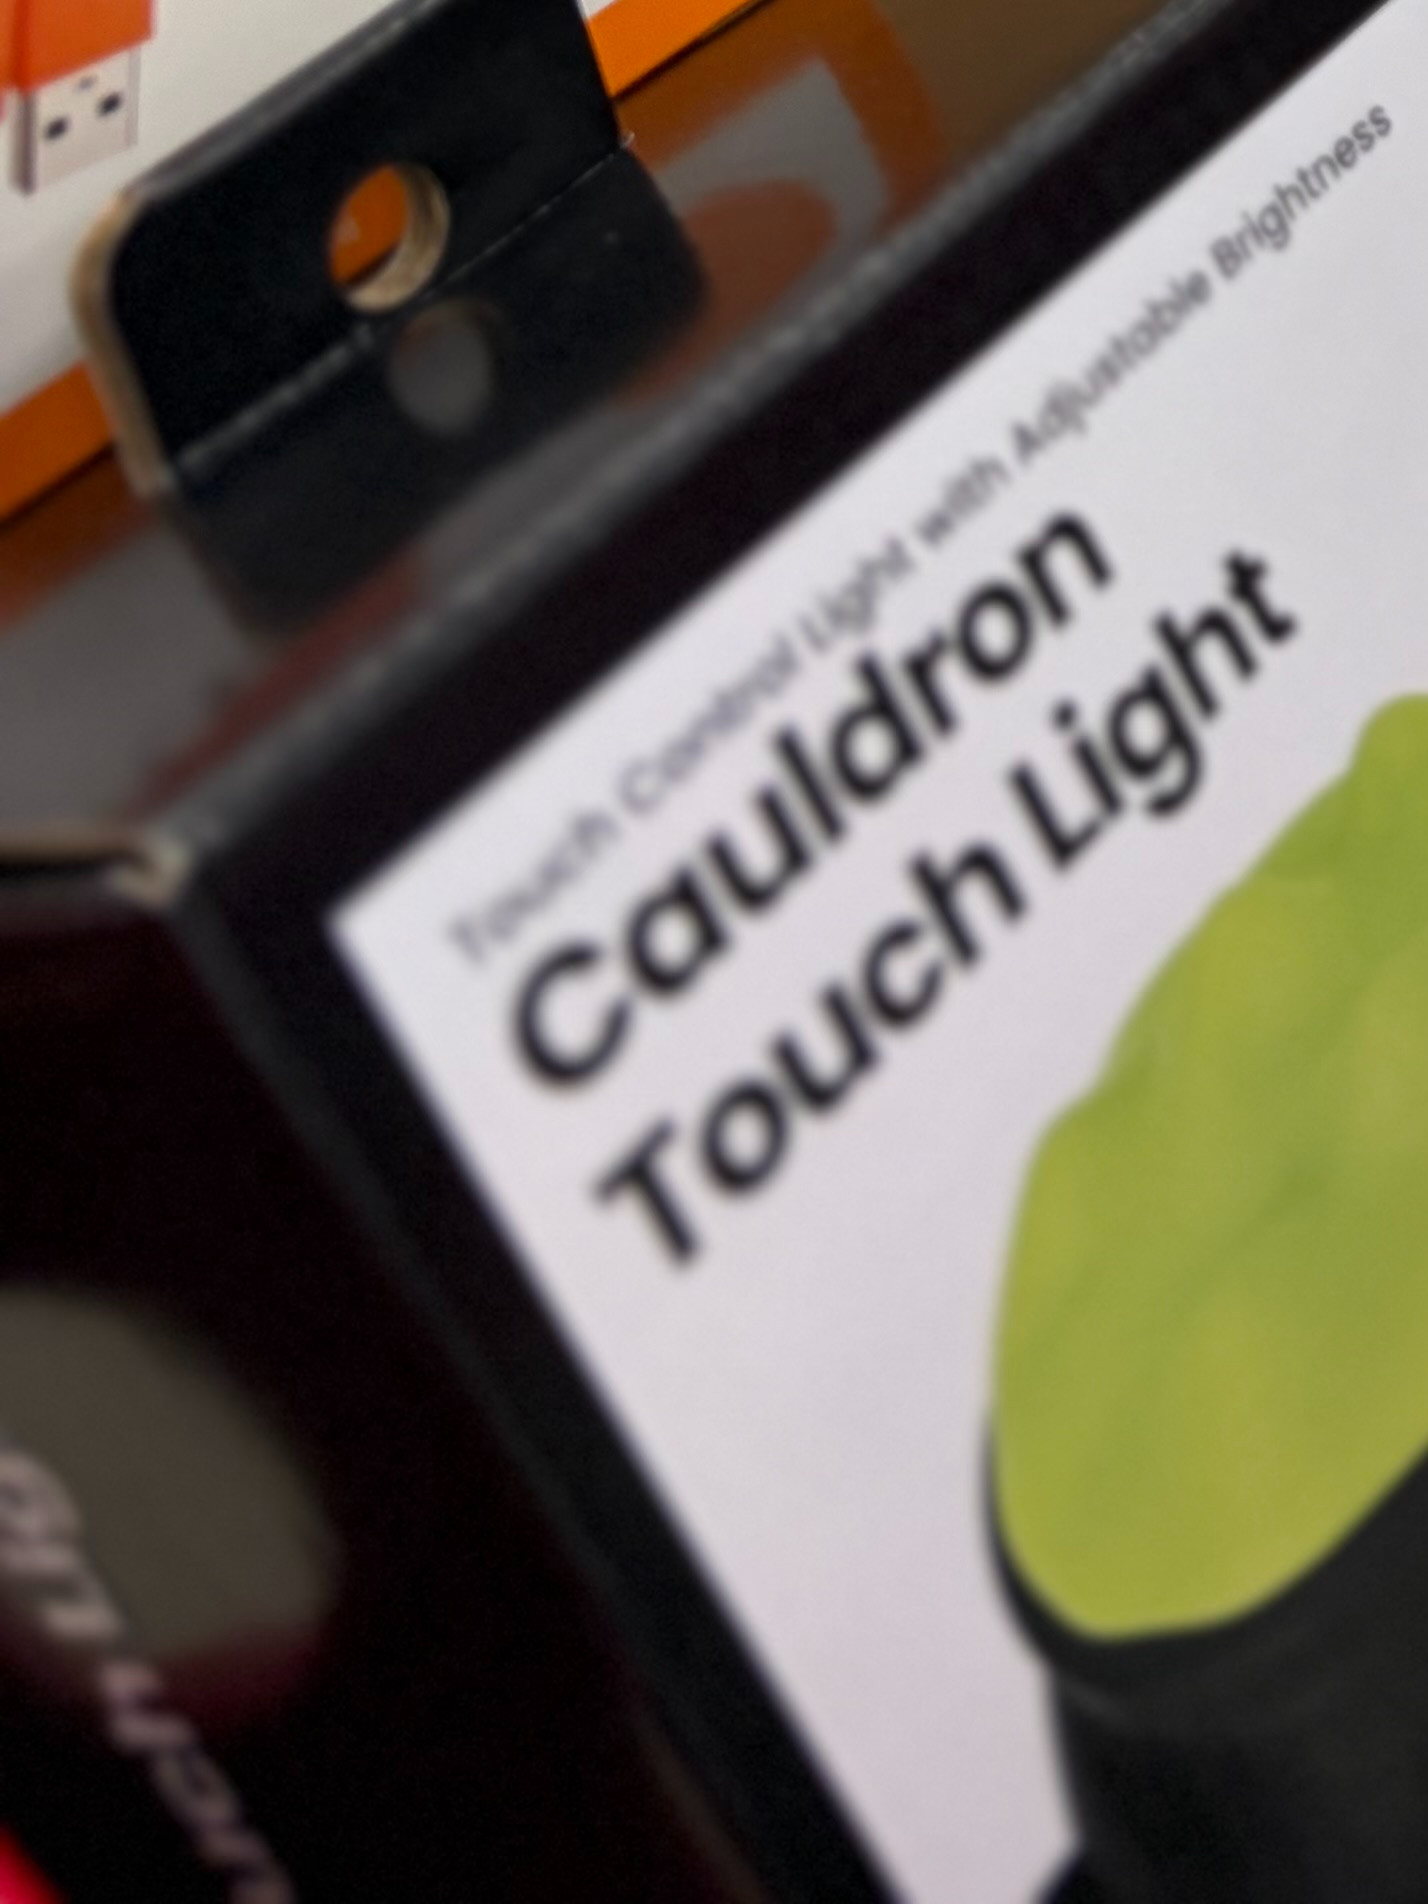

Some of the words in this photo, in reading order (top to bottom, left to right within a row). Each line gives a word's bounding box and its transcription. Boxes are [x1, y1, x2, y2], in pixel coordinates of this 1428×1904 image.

[450, 807, 618, 966] Touch
[612, 620, 805, 824] Control
[796, 530, 920, 662] Light
[913, 451, 1012, 545] with
[1006, 265, 1213, 465] Adjustable
[1206, 99, 1395, 283] Brightness
[503, 504, 1118, 1099] Cauldron
[592, 835, 1038, 1272] Touch
[1004, 547, 1300, 876] Light
